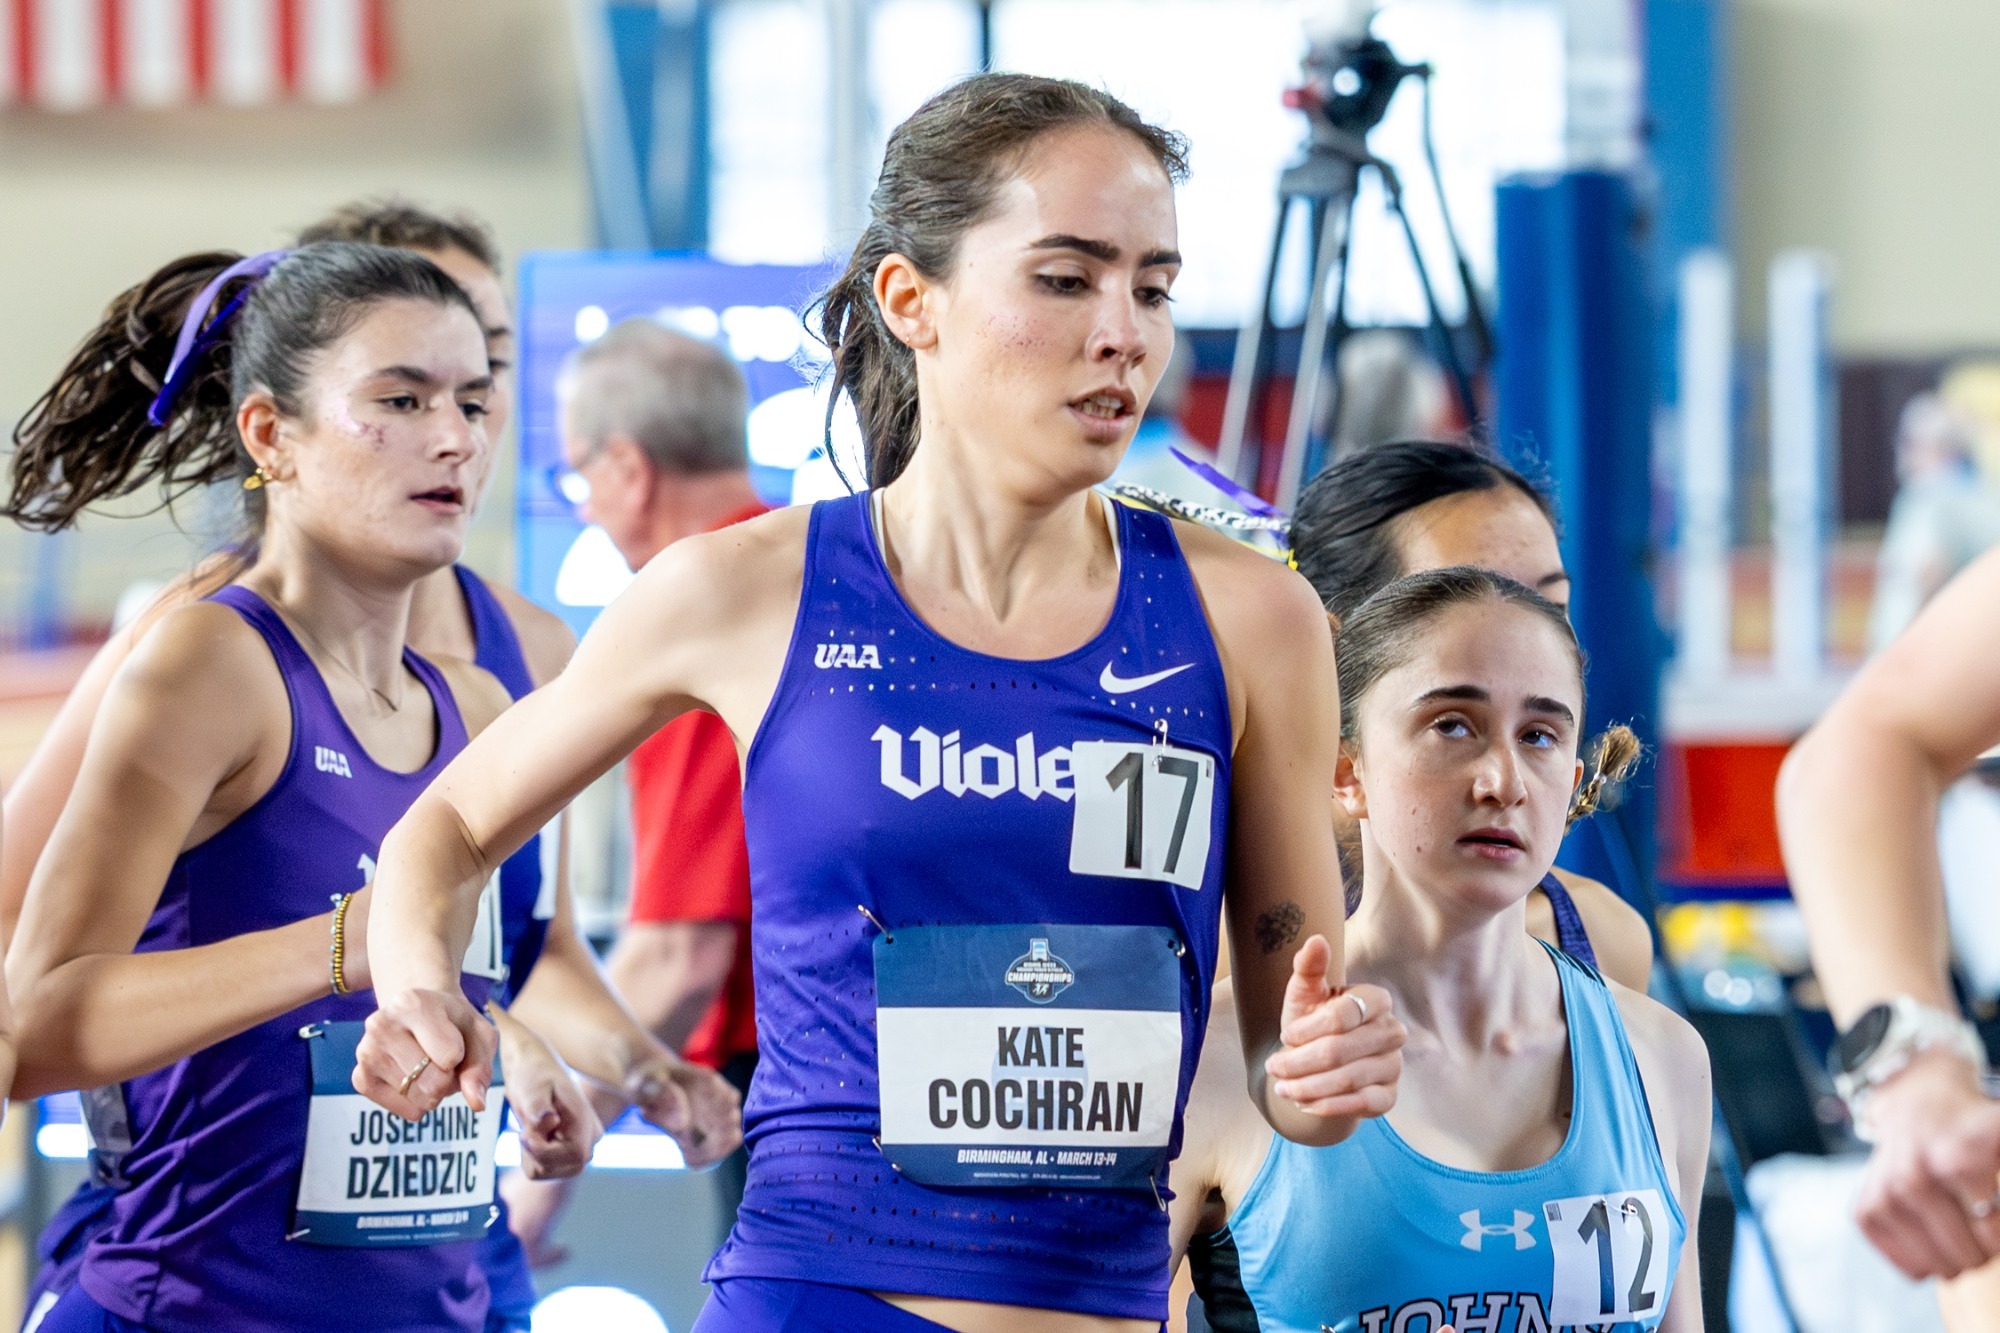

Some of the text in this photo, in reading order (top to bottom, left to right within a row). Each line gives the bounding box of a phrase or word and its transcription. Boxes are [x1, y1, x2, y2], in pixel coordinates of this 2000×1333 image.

[814, 643, 882, 669] UAA
[315, 746, 352, 778] UAA
[871, 724, 1076, 802] Viole
[1105, 751, 1199, 874] 17
[1007, 972, 1072, 983] CHAMPIONSHIPS
[997, 1026, 1084, 1068] KATE
[350, 1106, 480, 1145] JOSEPHINE
[928, 1078, 1143, 1132] COCHRAN
[347, 1150, 477, 1199] DZIEDZIC
[957, 1149, 1117, 1166] BIRMINGHAM, AL MARCH 13-14
[1577, 1197, 1656, 1315] 12
